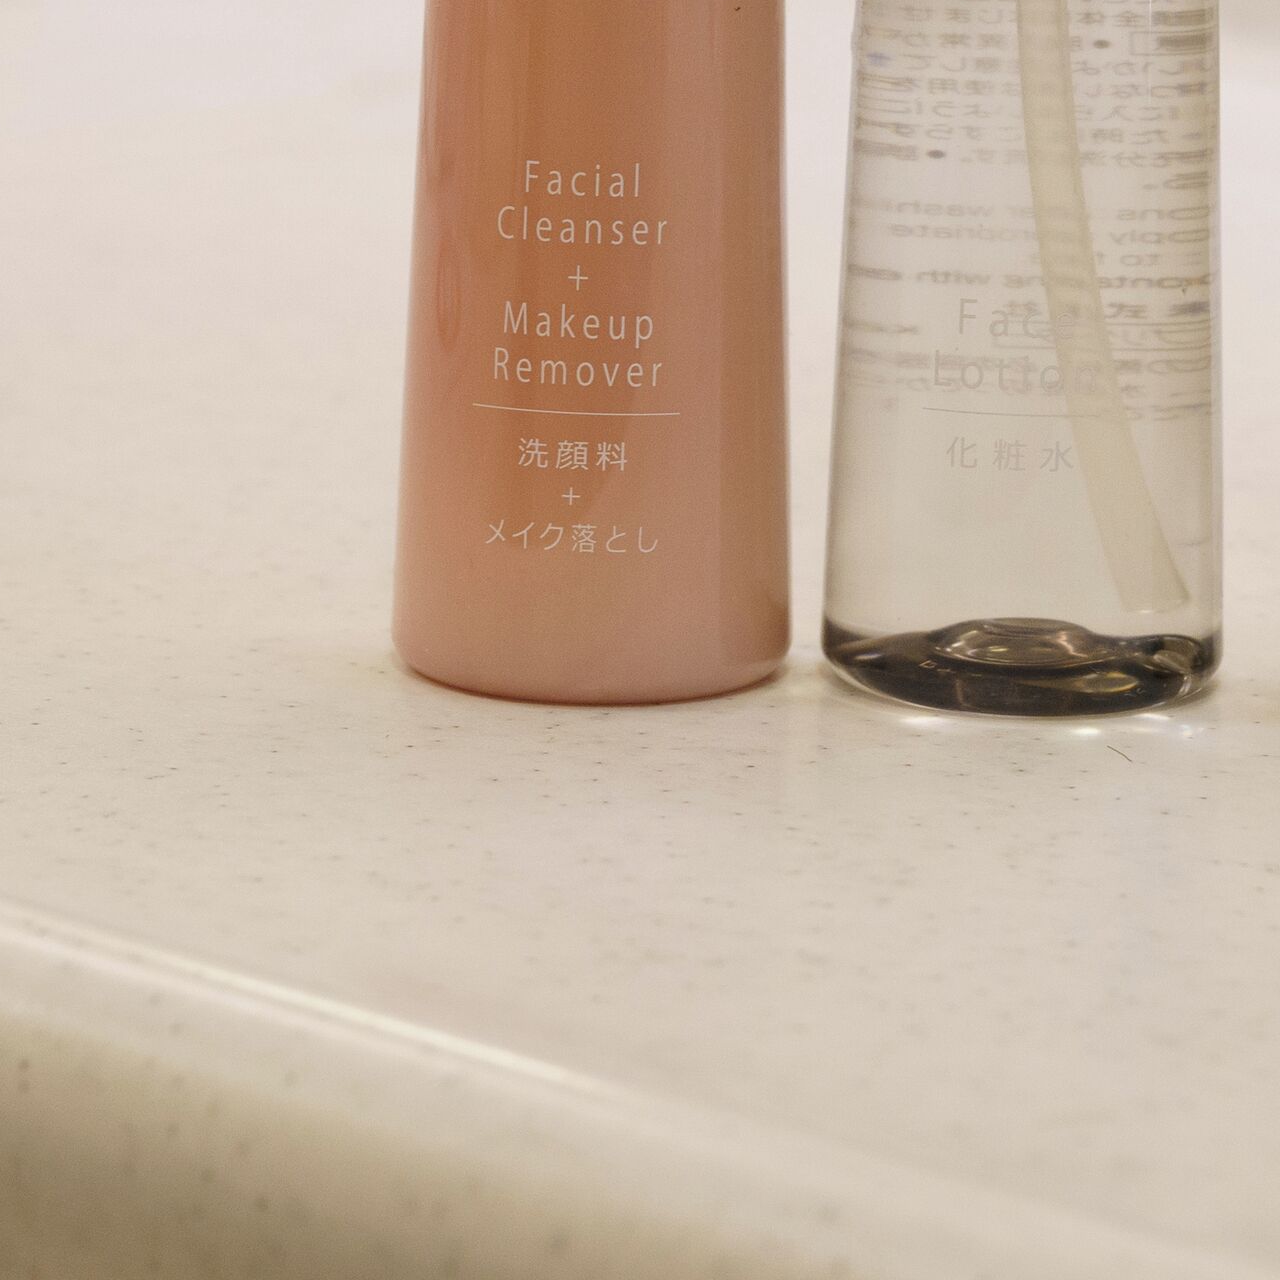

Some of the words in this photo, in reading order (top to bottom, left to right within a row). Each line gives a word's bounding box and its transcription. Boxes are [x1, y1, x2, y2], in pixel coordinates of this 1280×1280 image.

[523, 160, 641, 198] Facial
[496, 205, 669, 246] Cleanser
[567, 264, 589, 291] +
[502, 300, 655, 349] Makeup
[958, 297, 1076, 340] Face
[492, 346, 663, 388] Remover
[933, 349, 1097, 394] Lotion
[517, 436, 629, 472] 洗顔料
[945, 435, 1075, 473] 化粧水
[561, 486, 581, 506] +
[484, 518, 660, 555] メイク落とし
